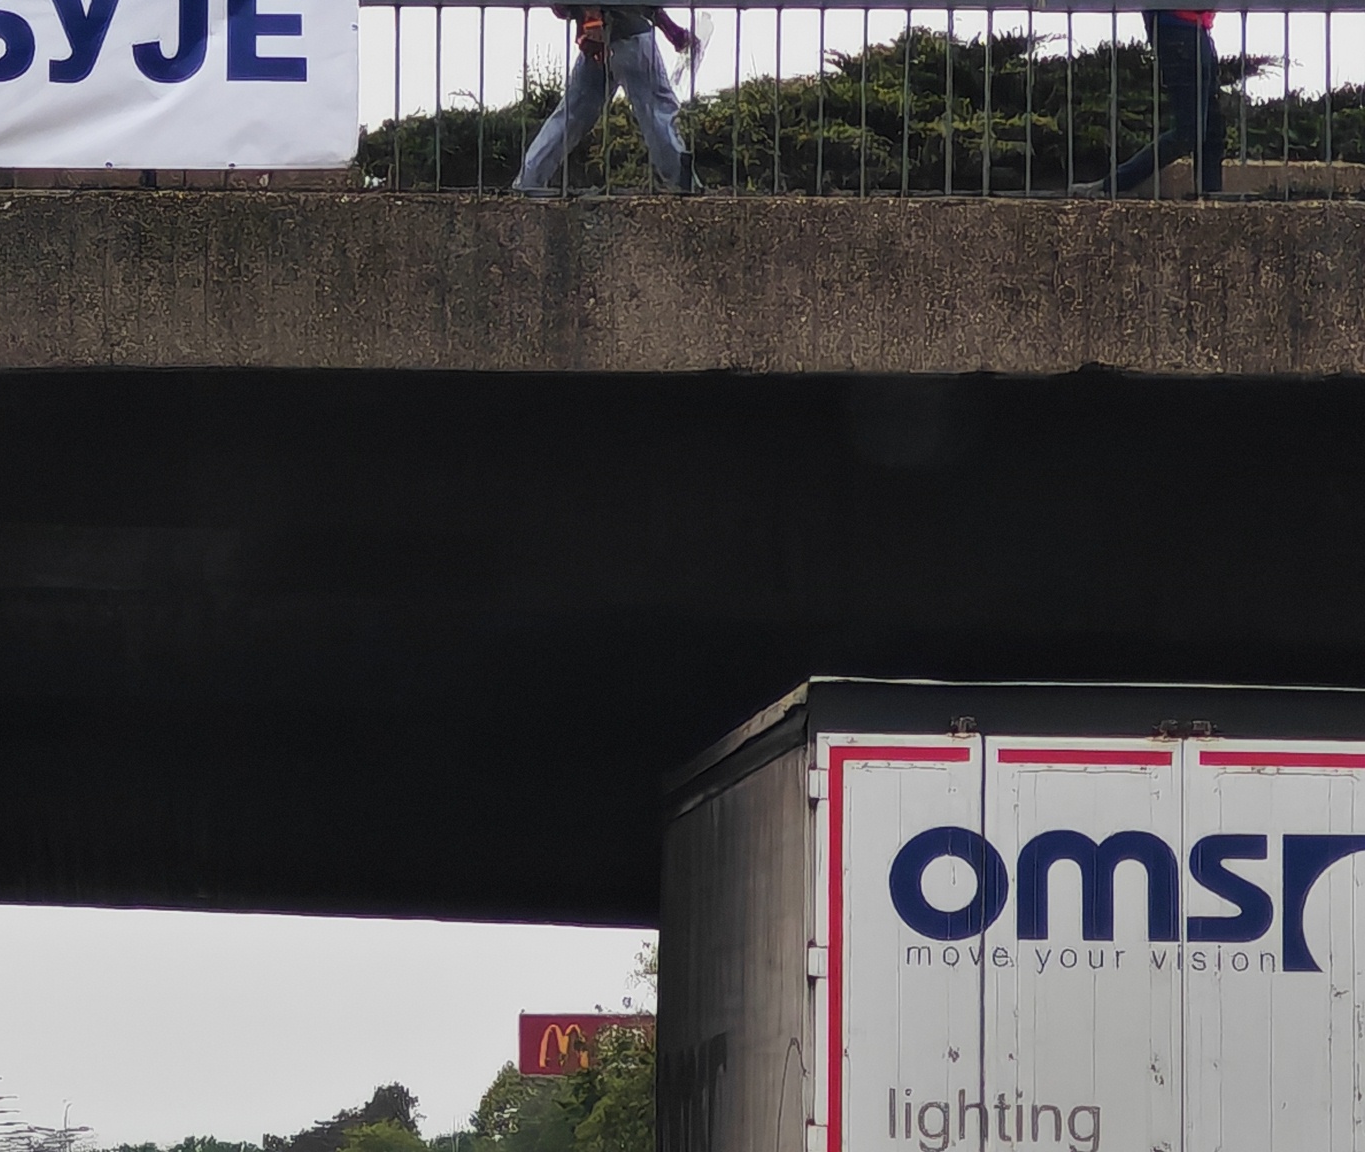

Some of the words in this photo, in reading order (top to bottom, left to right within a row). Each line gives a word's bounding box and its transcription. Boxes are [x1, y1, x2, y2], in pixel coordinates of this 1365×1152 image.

[905, 944, 1010, 969] move
[1033, 946, 1126, 976] your
[1150, 944, 1277, 974] vision
[887, 1086, 1102, 1152] lighting
